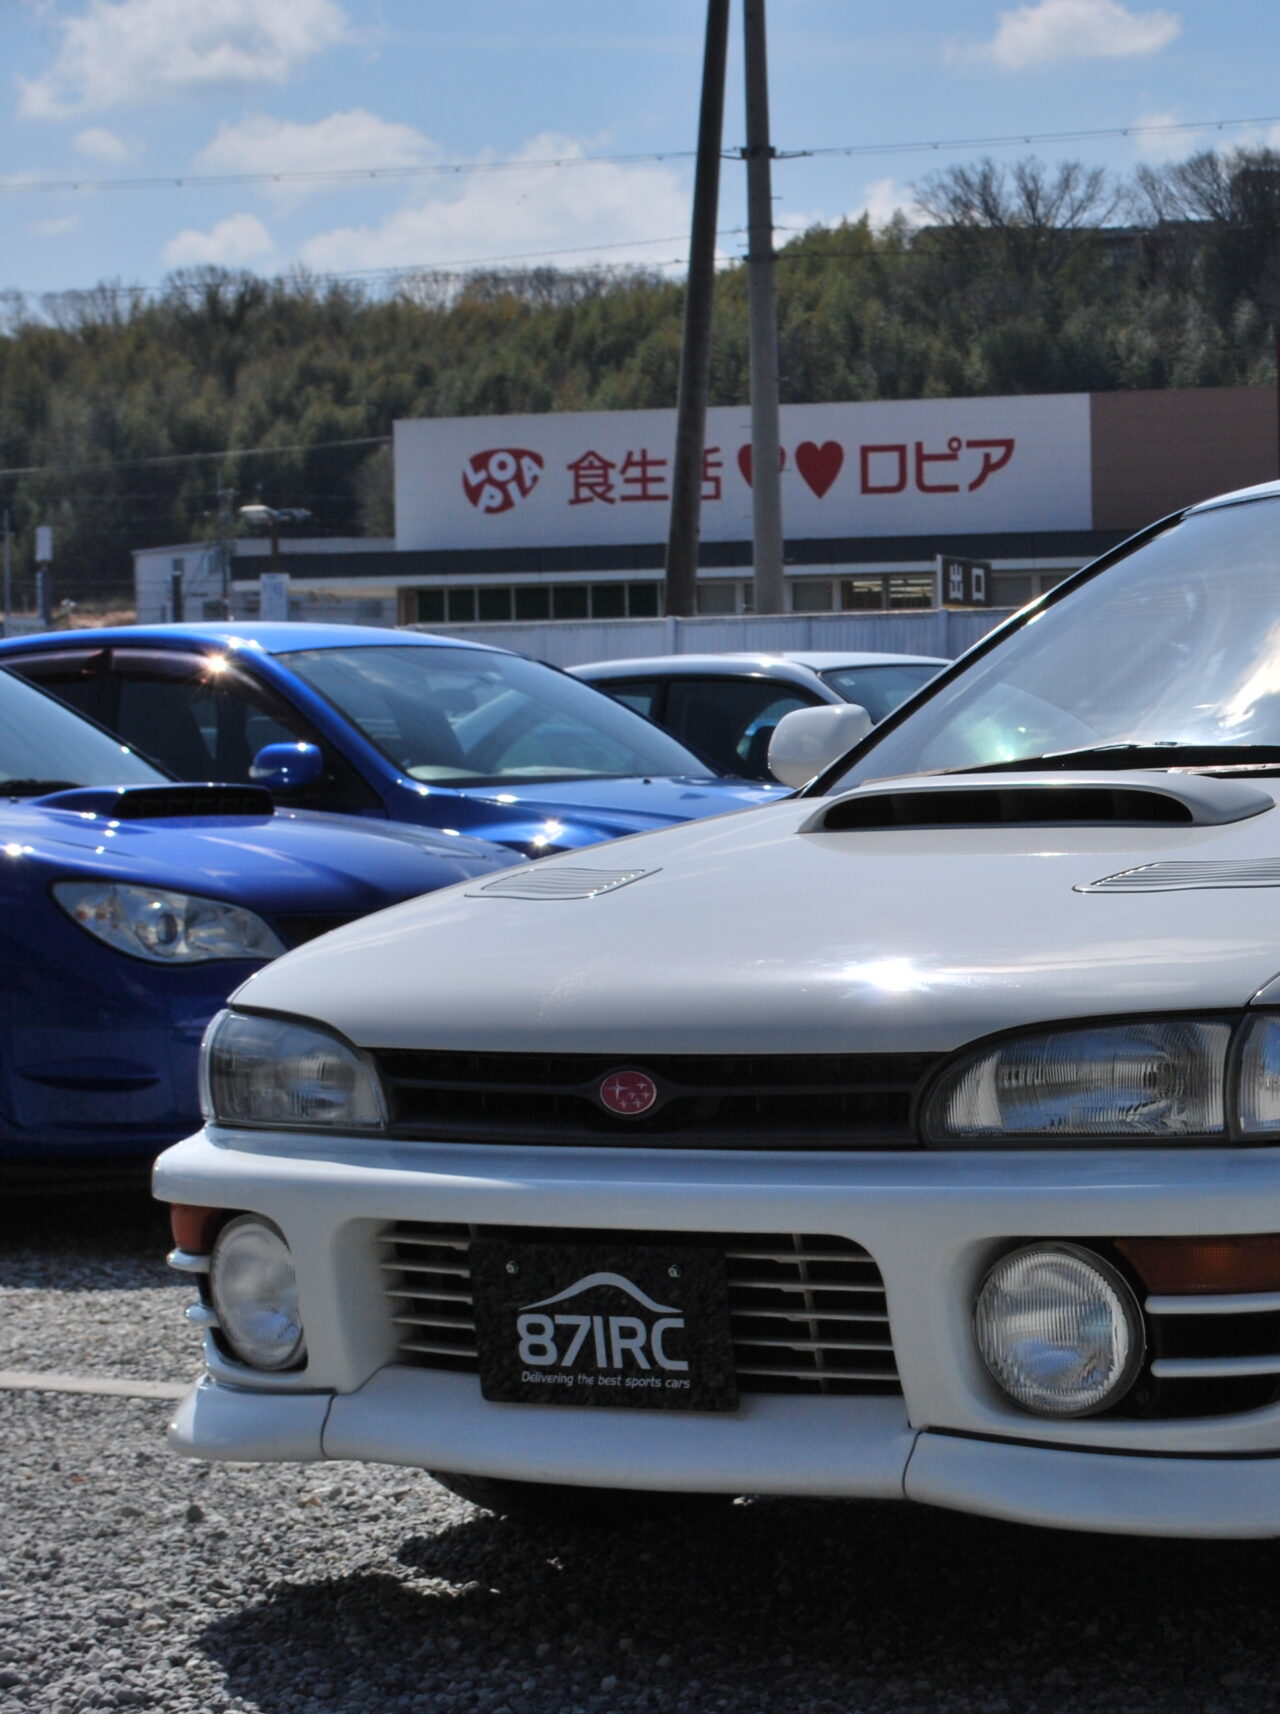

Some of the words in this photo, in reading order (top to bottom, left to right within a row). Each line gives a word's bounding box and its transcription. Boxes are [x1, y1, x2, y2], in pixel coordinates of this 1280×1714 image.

[860, 437, 1015, 495] ロピア
[949, 563, 985, 602] 出口
[521, 1371, 574, 1387] Delivering
[577, 1373, 594, 1385] the
[597, 1374, 621, 1387] best
[625, 1376, 661, 1390] sports
[665, 1378, 691, 1389] cars
